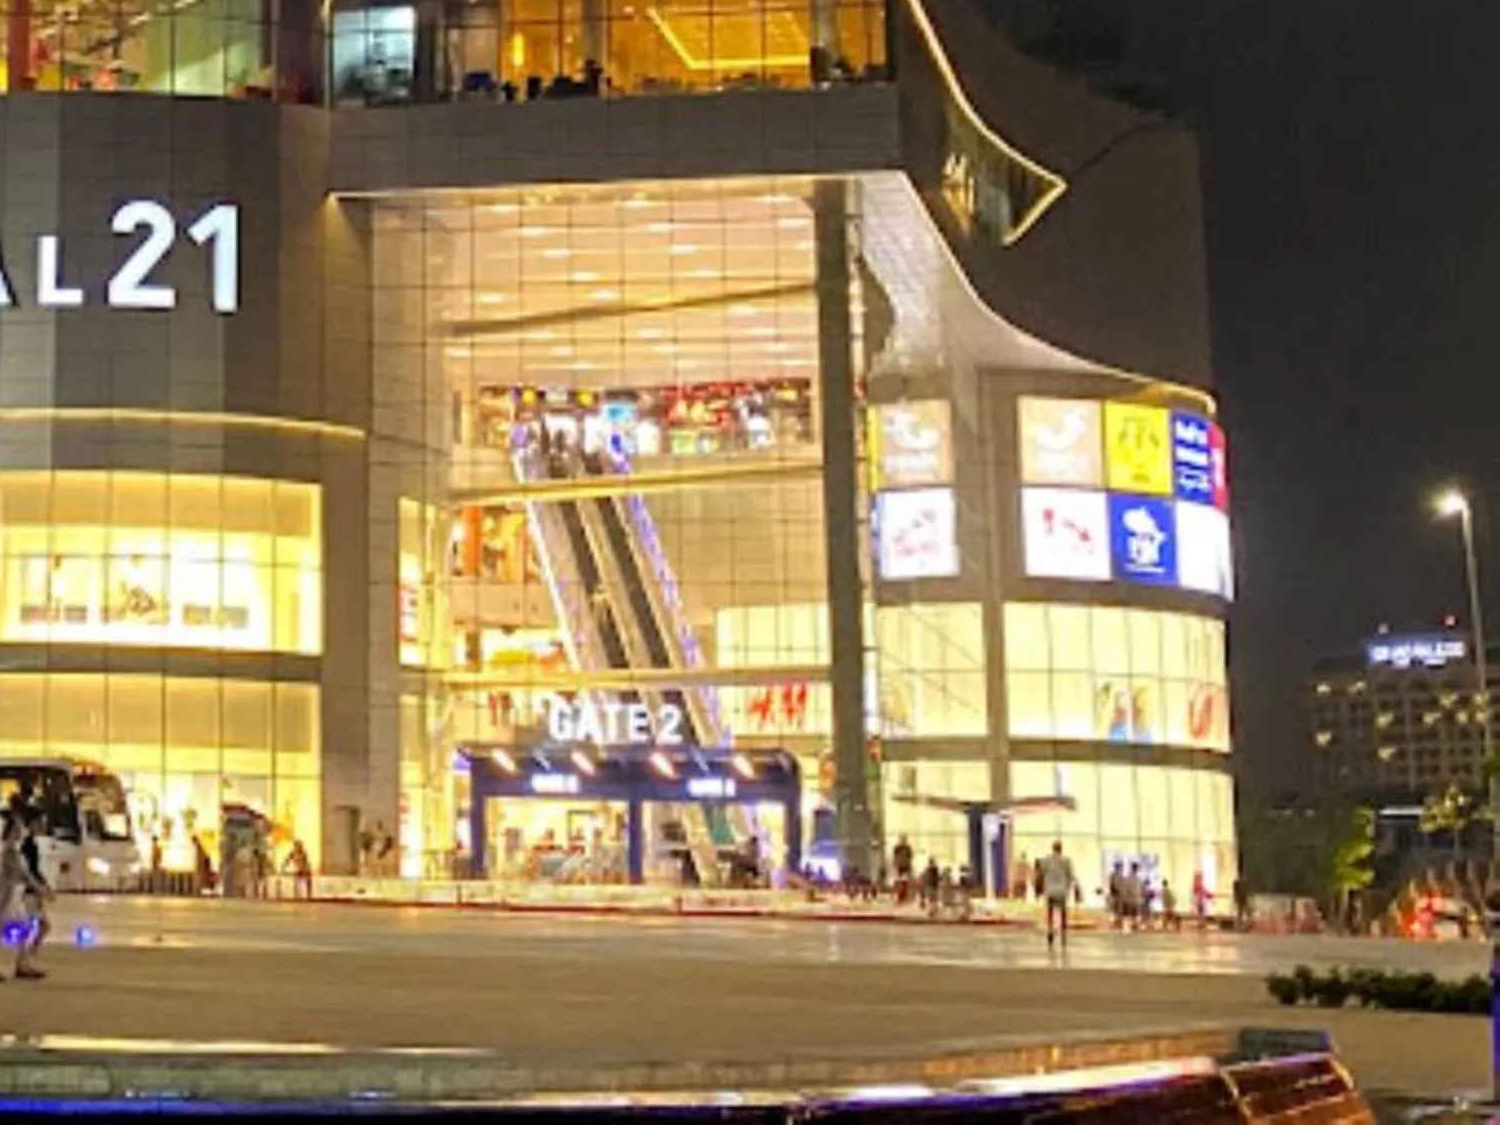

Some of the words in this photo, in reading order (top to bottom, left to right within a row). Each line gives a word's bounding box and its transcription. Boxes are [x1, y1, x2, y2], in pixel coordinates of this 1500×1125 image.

[107, 200, 238, 313] 21
[549, 702, 649, 743] GATE
[655, 702, 683, 744] 2
